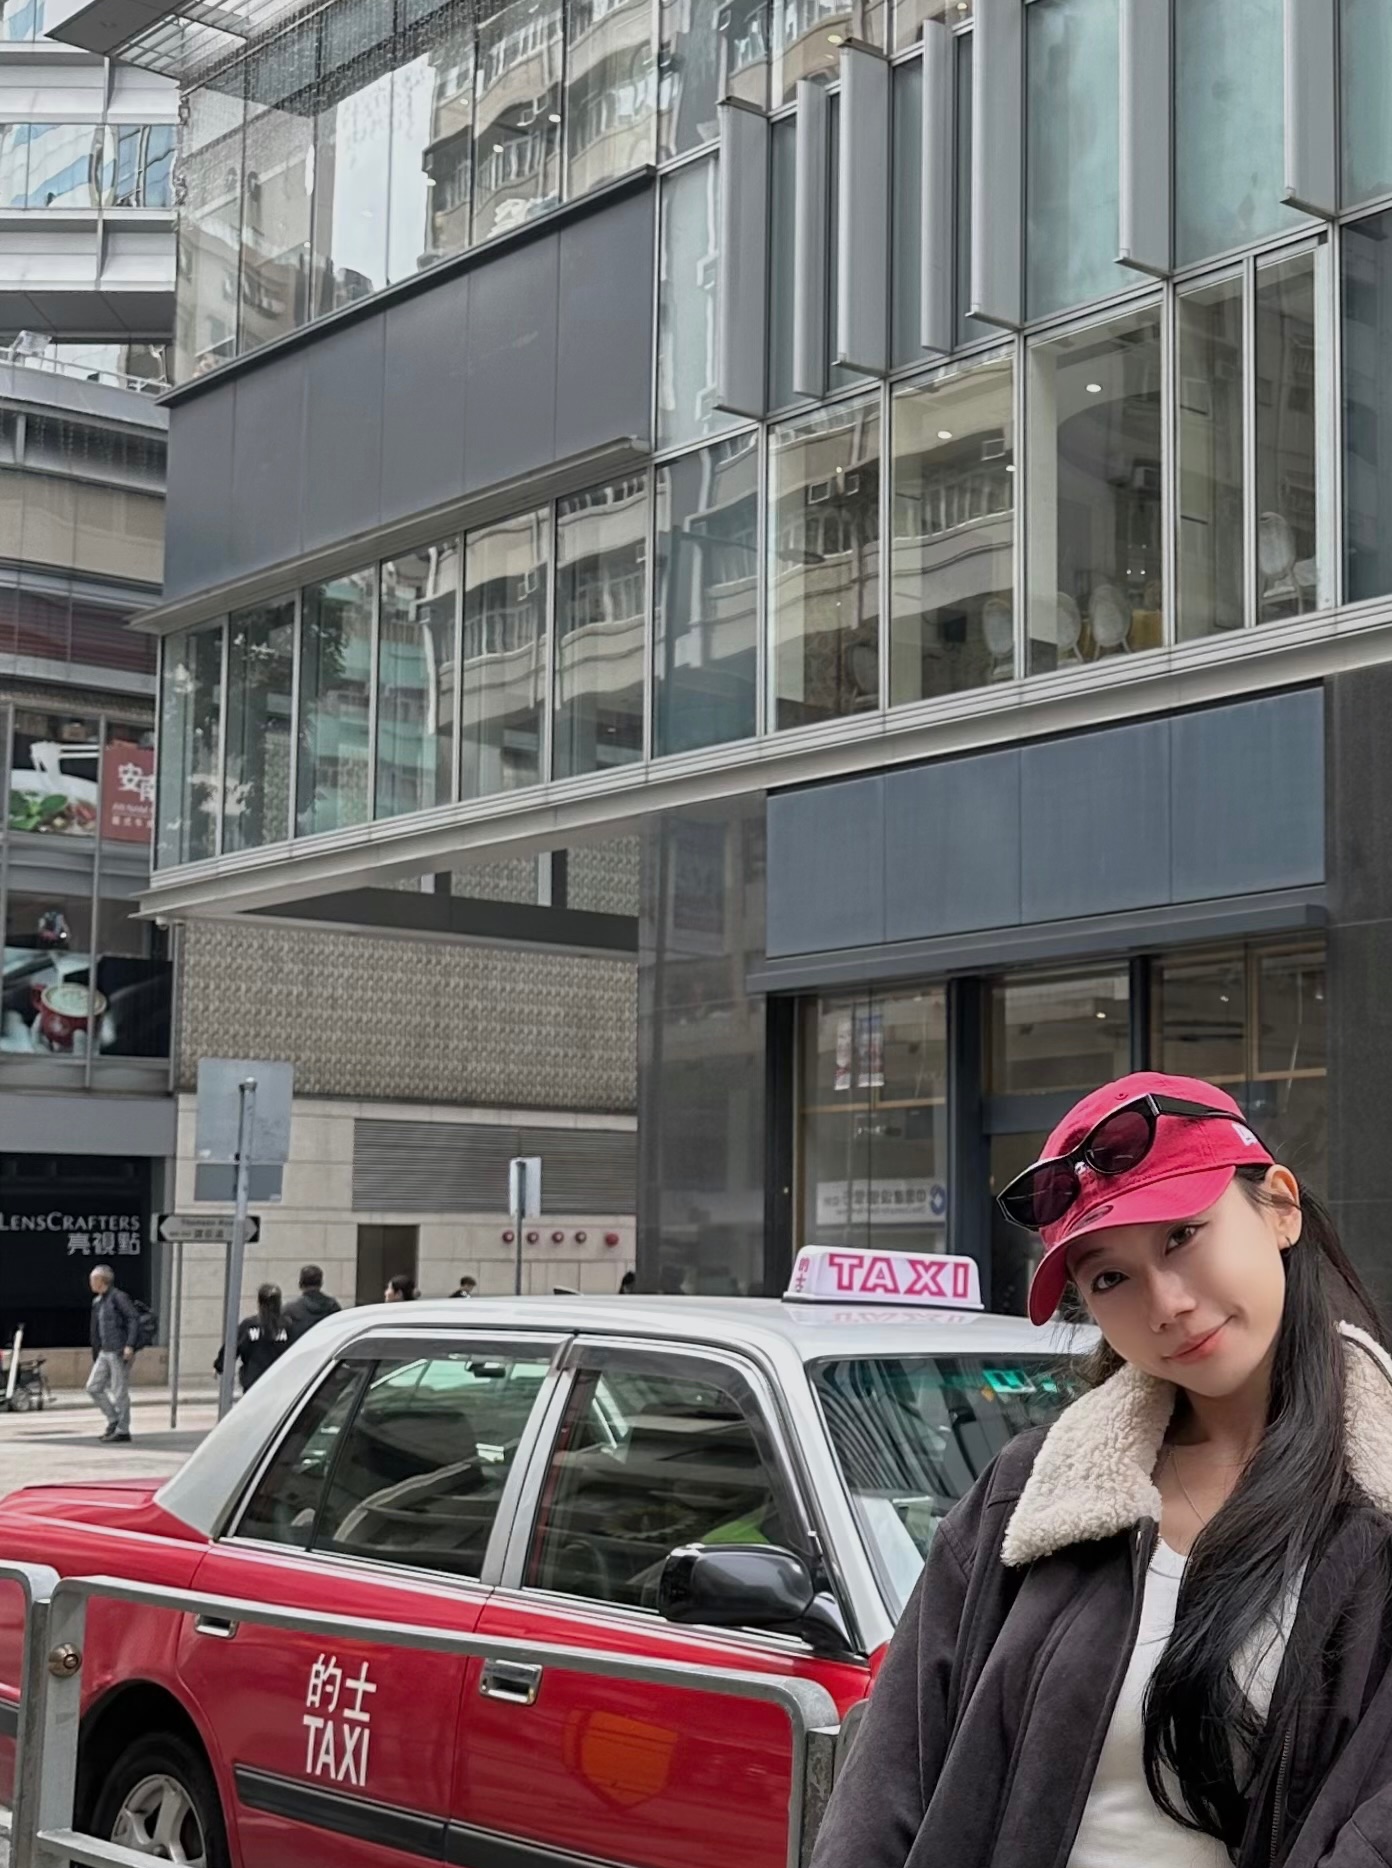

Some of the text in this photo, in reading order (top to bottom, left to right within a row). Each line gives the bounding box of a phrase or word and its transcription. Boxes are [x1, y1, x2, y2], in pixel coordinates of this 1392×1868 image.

[67, 1232, 141, 1256] 亮視點
[828, 1253, 970, 1299] TAXI
[306, 1653, 377, 1723] 的士
[303, 1714, 370, 1788] TAXI
